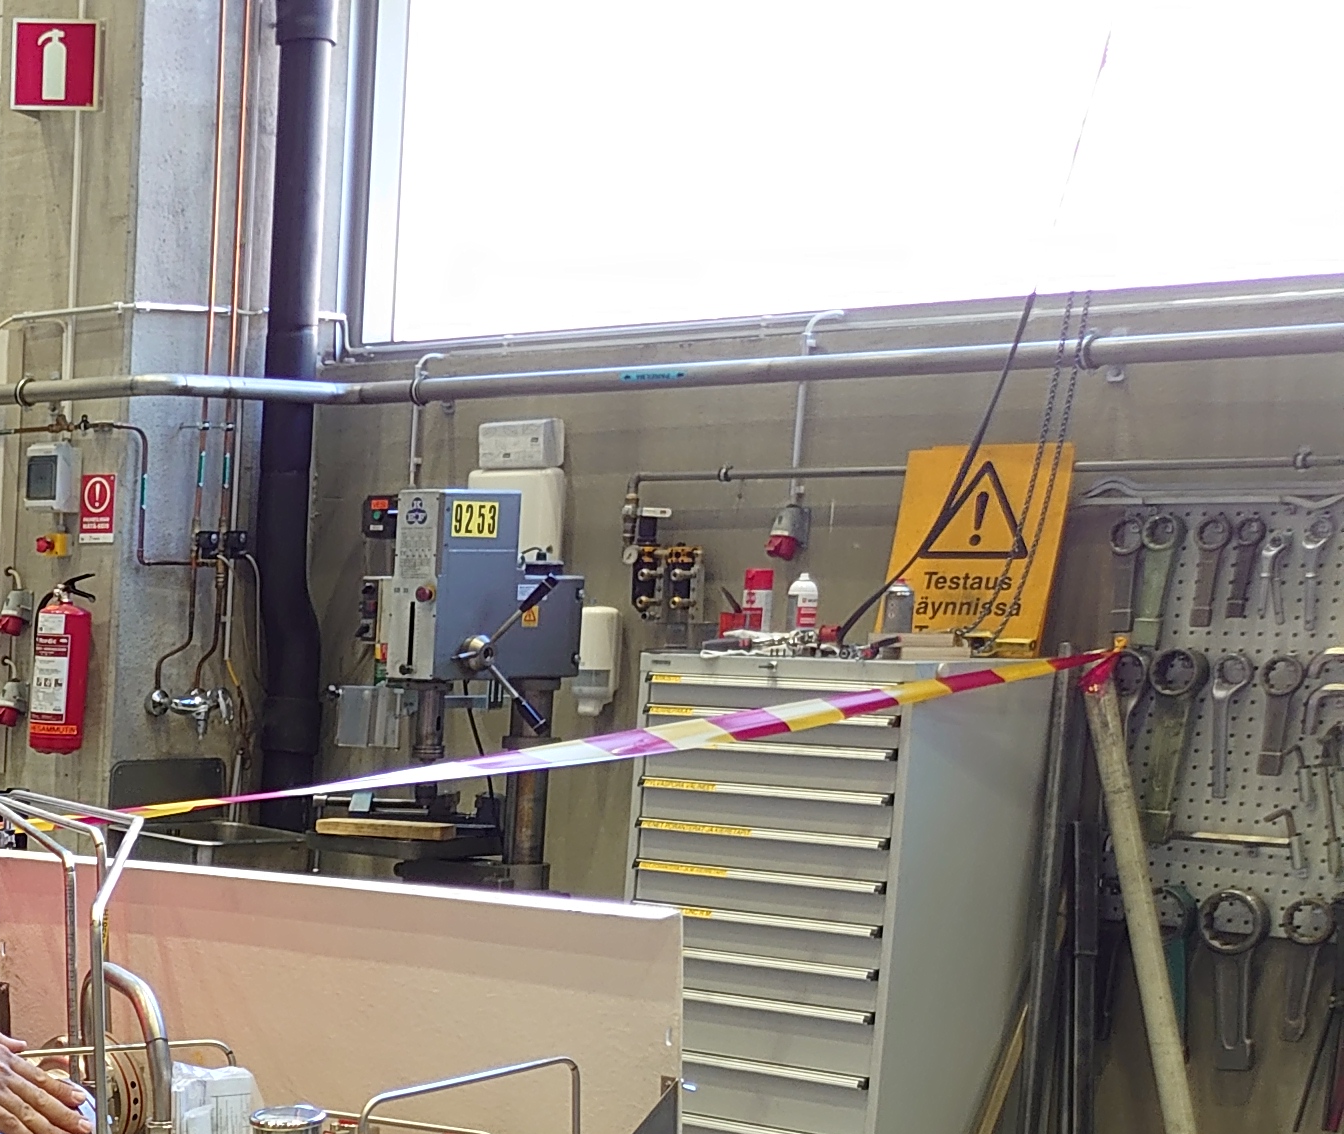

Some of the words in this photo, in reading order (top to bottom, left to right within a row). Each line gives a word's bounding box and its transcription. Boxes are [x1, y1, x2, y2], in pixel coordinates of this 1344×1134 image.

[453, 503, 497, 534] 9253
[923, 571, 1013, 591] Testaus
[915, 597, 1022, 619] äynnissä
